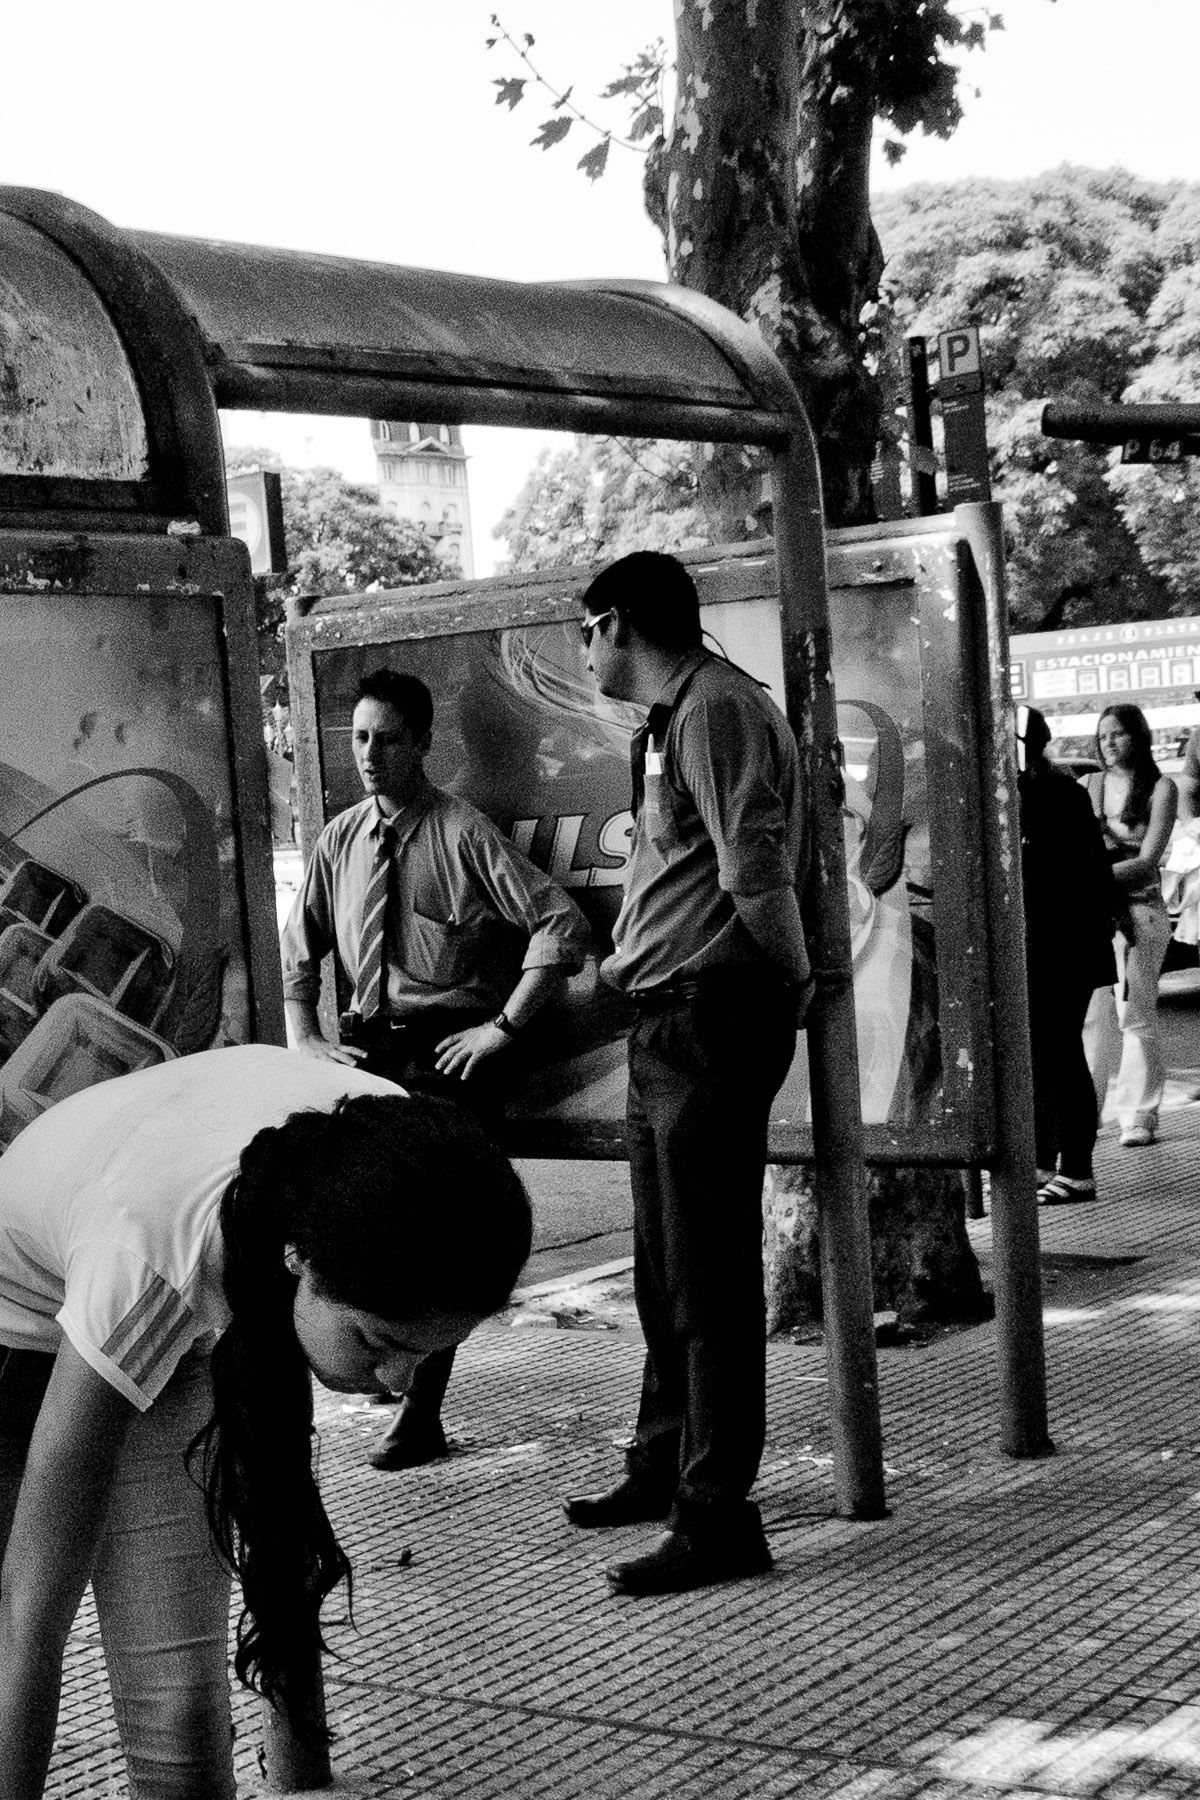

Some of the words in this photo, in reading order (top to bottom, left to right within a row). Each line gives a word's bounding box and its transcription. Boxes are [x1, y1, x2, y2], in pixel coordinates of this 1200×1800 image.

[947, 334, 970, 372] P
[1124, 439, 1140, 460] P
[1149, 439, 1181, 460] 64
